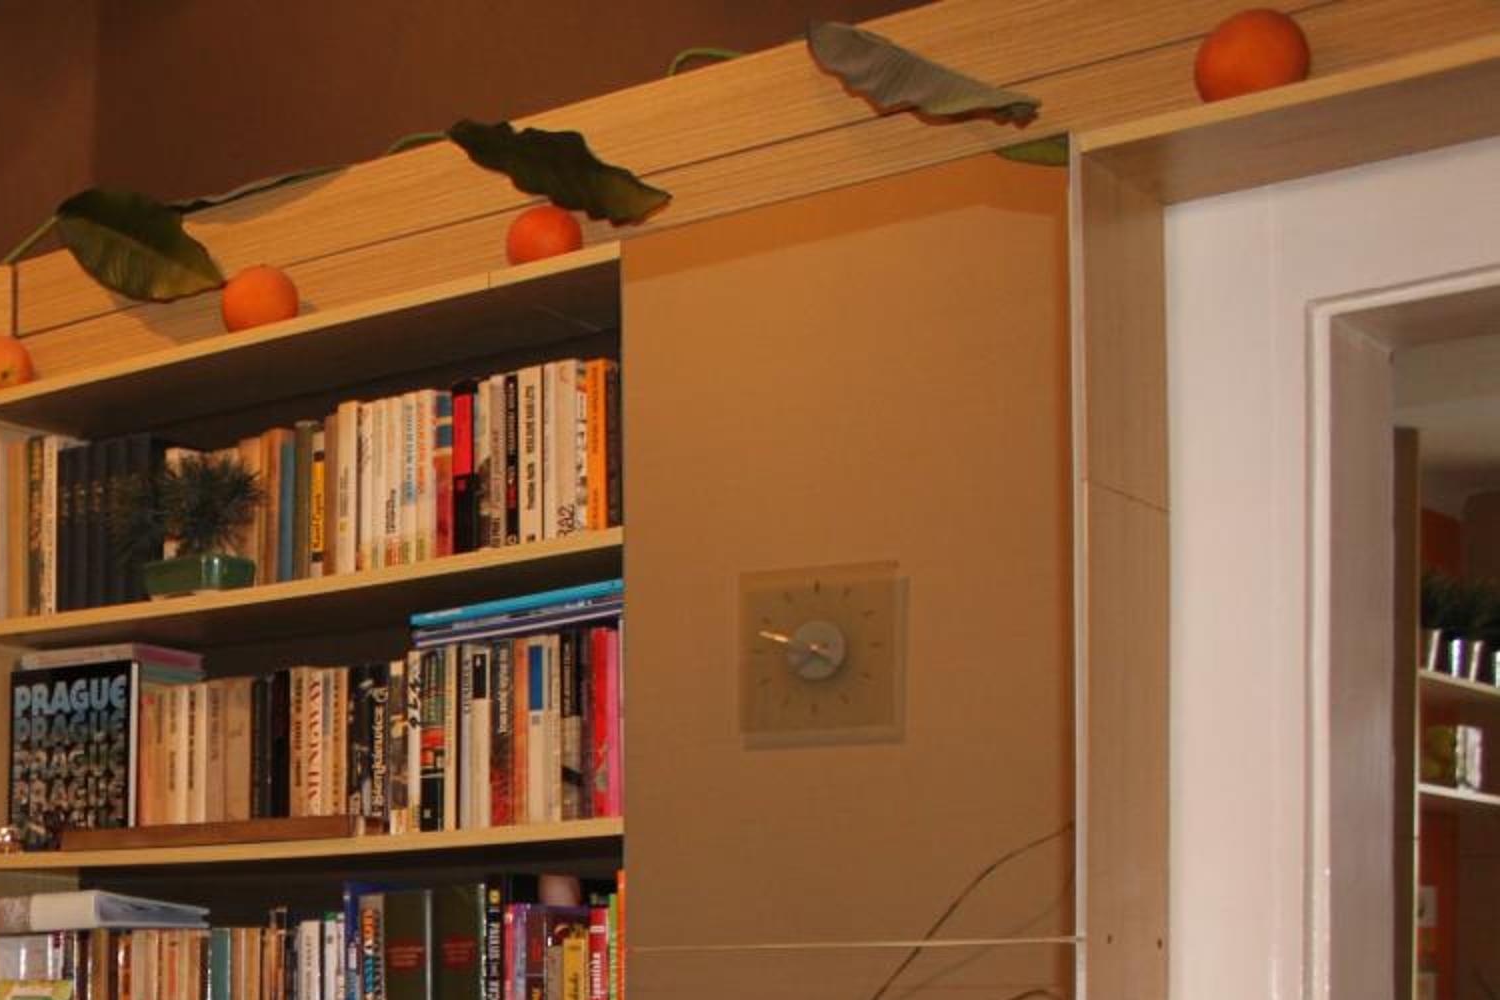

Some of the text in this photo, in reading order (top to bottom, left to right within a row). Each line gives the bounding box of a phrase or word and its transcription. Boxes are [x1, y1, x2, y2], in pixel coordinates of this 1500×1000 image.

[14, 674, 127, 719] PRAGUE
[14, 711, 125, 747] PRAGUE
[13, 744, 125, 779] PRAGUE
